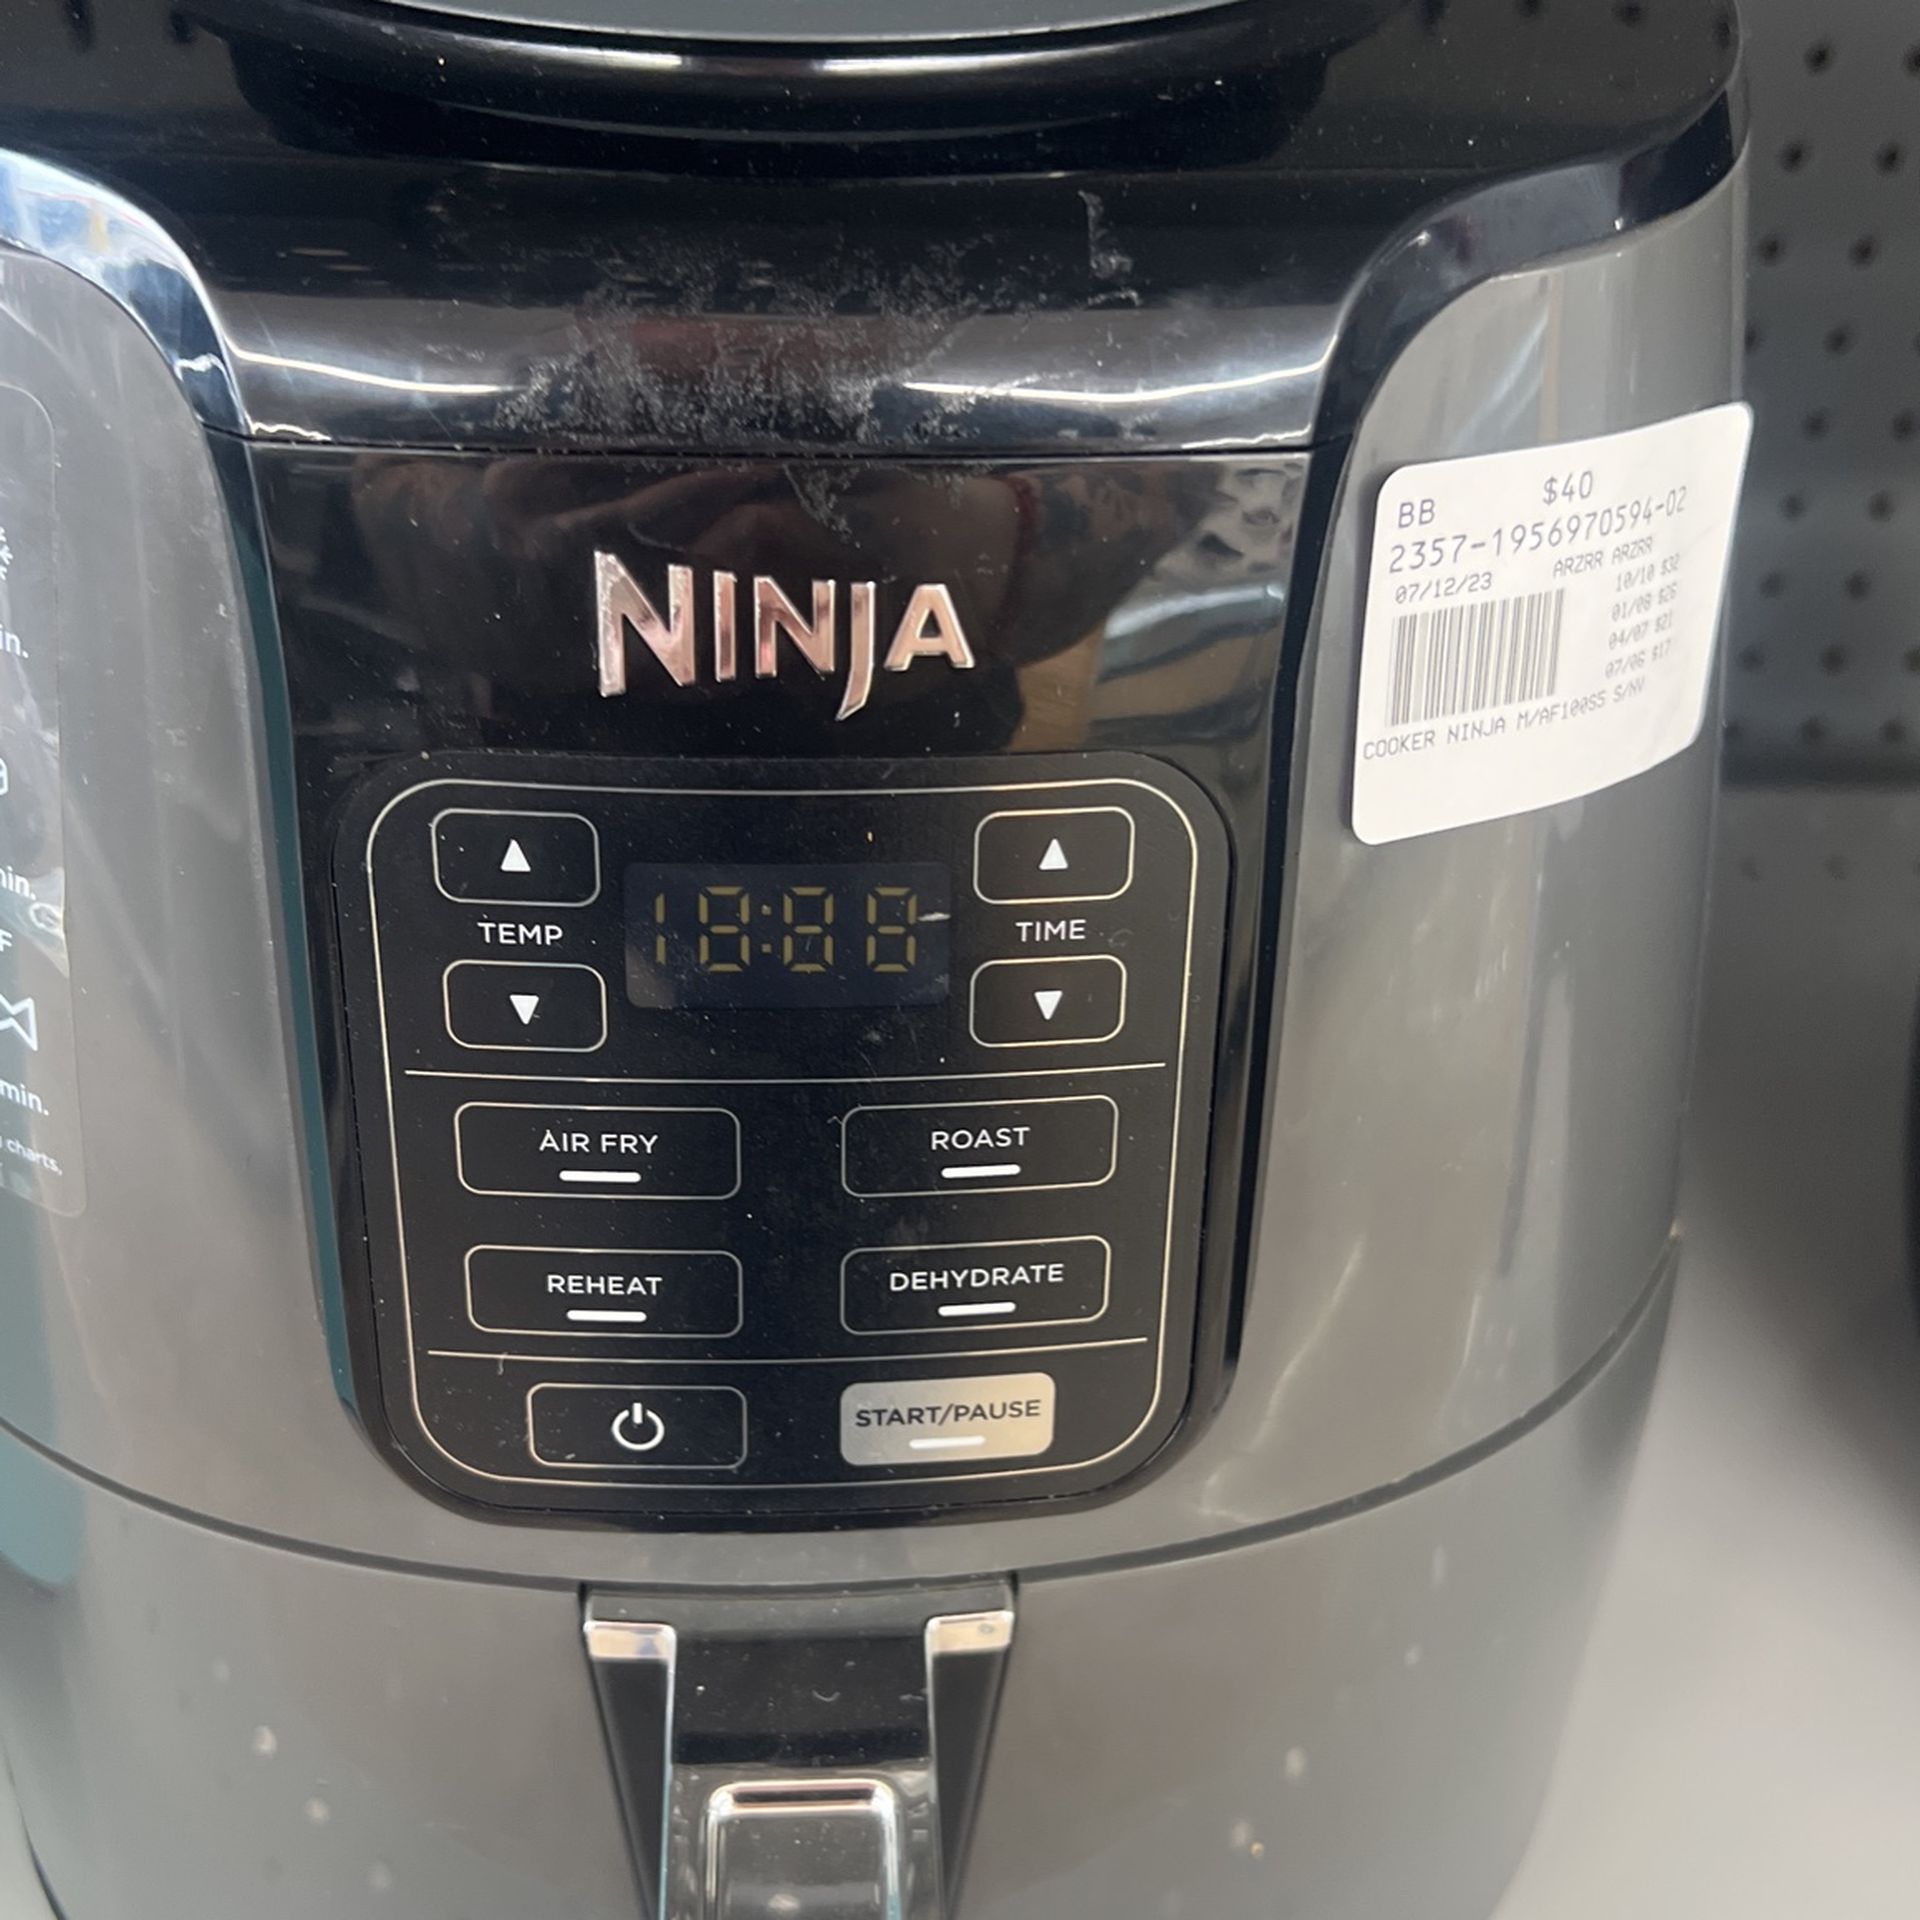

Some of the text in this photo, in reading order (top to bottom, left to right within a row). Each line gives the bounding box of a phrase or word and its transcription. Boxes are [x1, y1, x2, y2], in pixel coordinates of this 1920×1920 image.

[1398, 470, 1594, 528] BB $40
[1389, 485, 1688, 574] 2357-1956970594-02
[1395, 571, 1493, 605] 07/12/23
[593, 550, 975, 720] NINJA
[1363, 729, 1436, 761] COOKER
[1447, 716, 1506, 745] NINJA
[477, 922, 563, 946] TEMP
[1015, 918, 1087, 943] TIME
[540, 1131, 659, 1154] AIR FRY
[931, 1126, 1031, 1150] ROAST
[547, 1274, 663, 1296] REHEAT
[890, 1263, 1065, 1292] DEHYDRATE
[855, 1399, 1042, 1427] START/PAUSE
